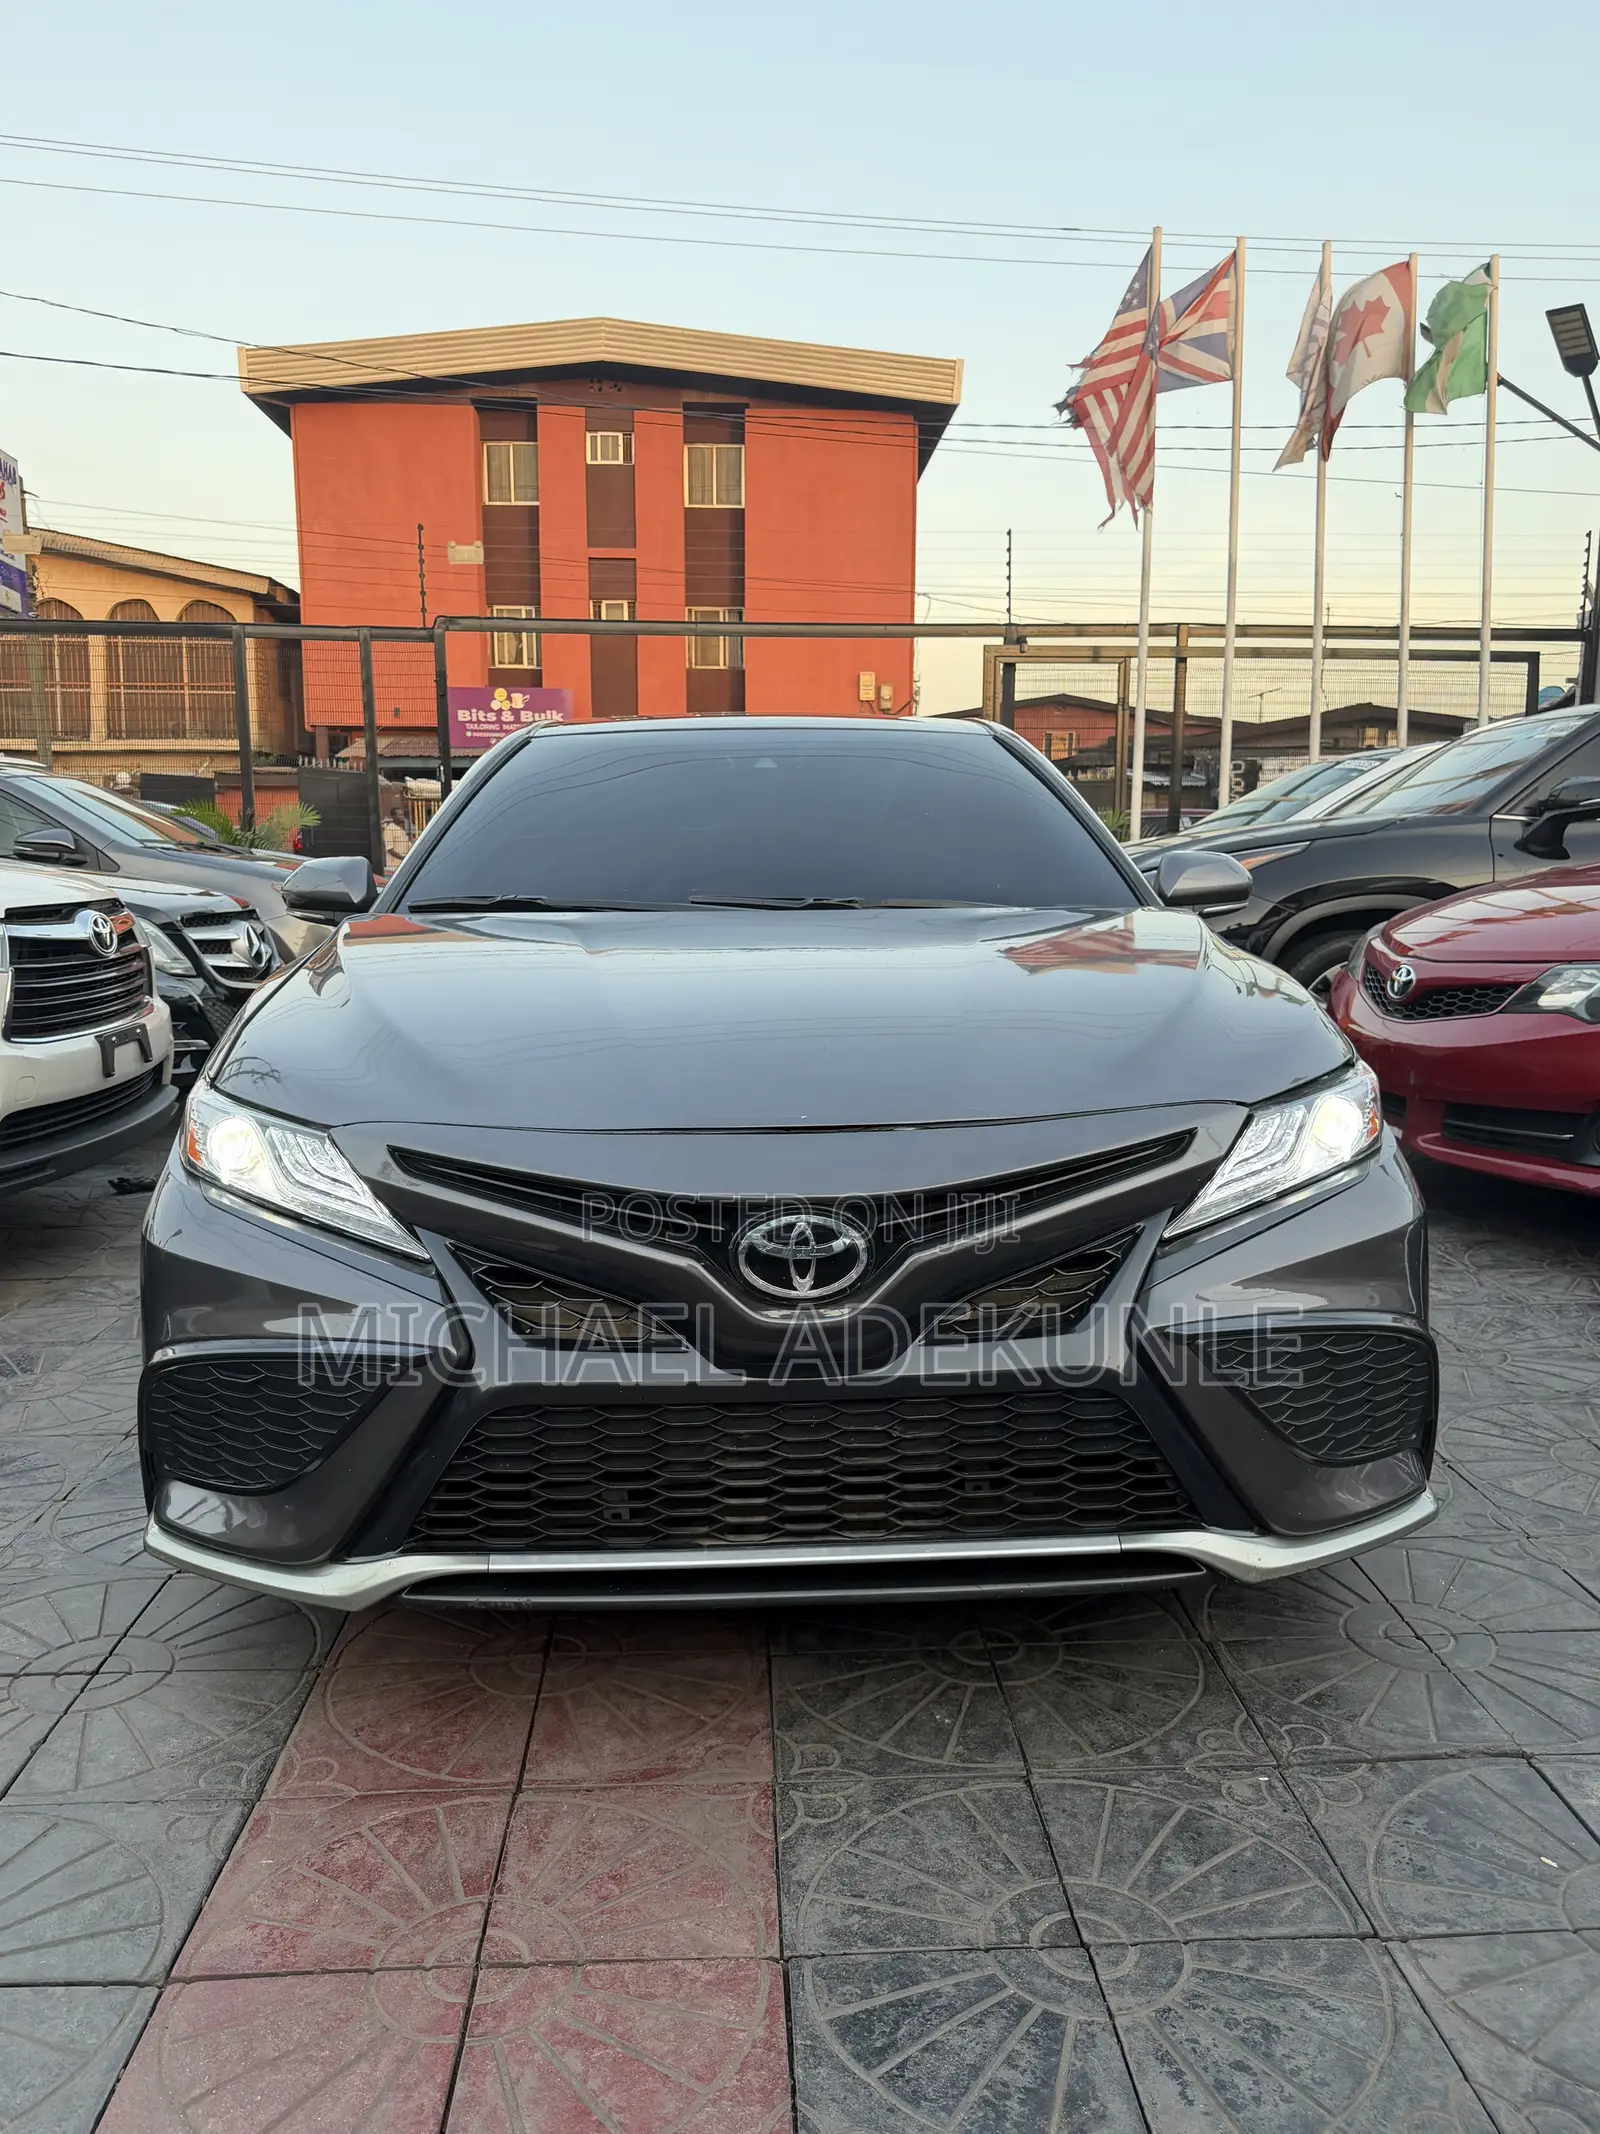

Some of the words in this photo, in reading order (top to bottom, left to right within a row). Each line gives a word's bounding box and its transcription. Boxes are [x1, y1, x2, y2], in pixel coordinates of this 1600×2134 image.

[457, 708, 497, 722] Bits
[501, 710, 515, 722] &
[520, 710, 564, 722] Bulk
